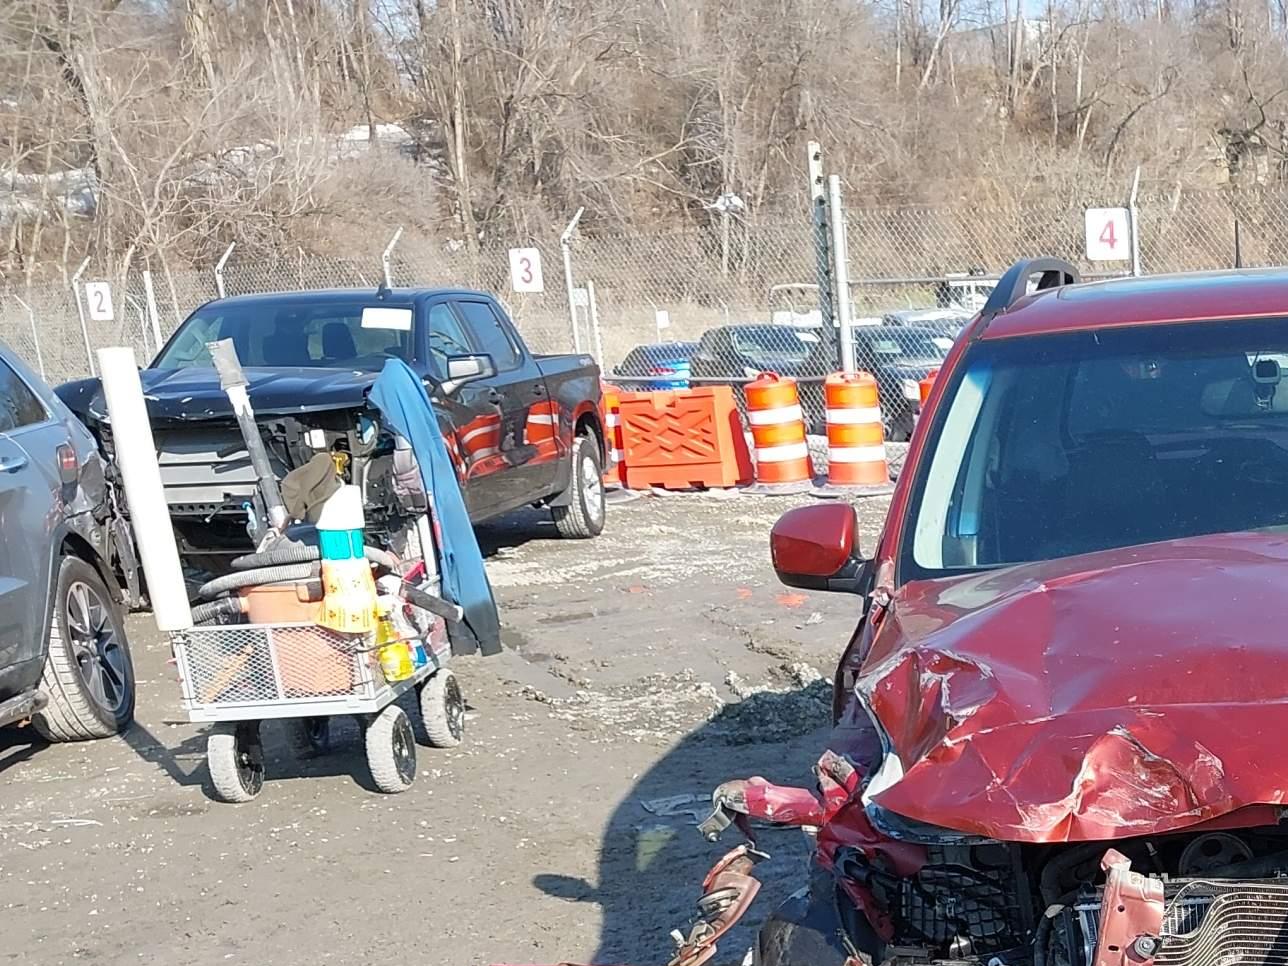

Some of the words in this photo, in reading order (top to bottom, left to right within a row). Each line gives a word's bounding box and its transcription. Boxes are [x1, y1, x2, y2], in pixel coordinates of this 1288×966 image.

[1099, 220, 1118, 249] 4
[520, 257, 533, 284] 3
[94, 290, 106, 313] 2
